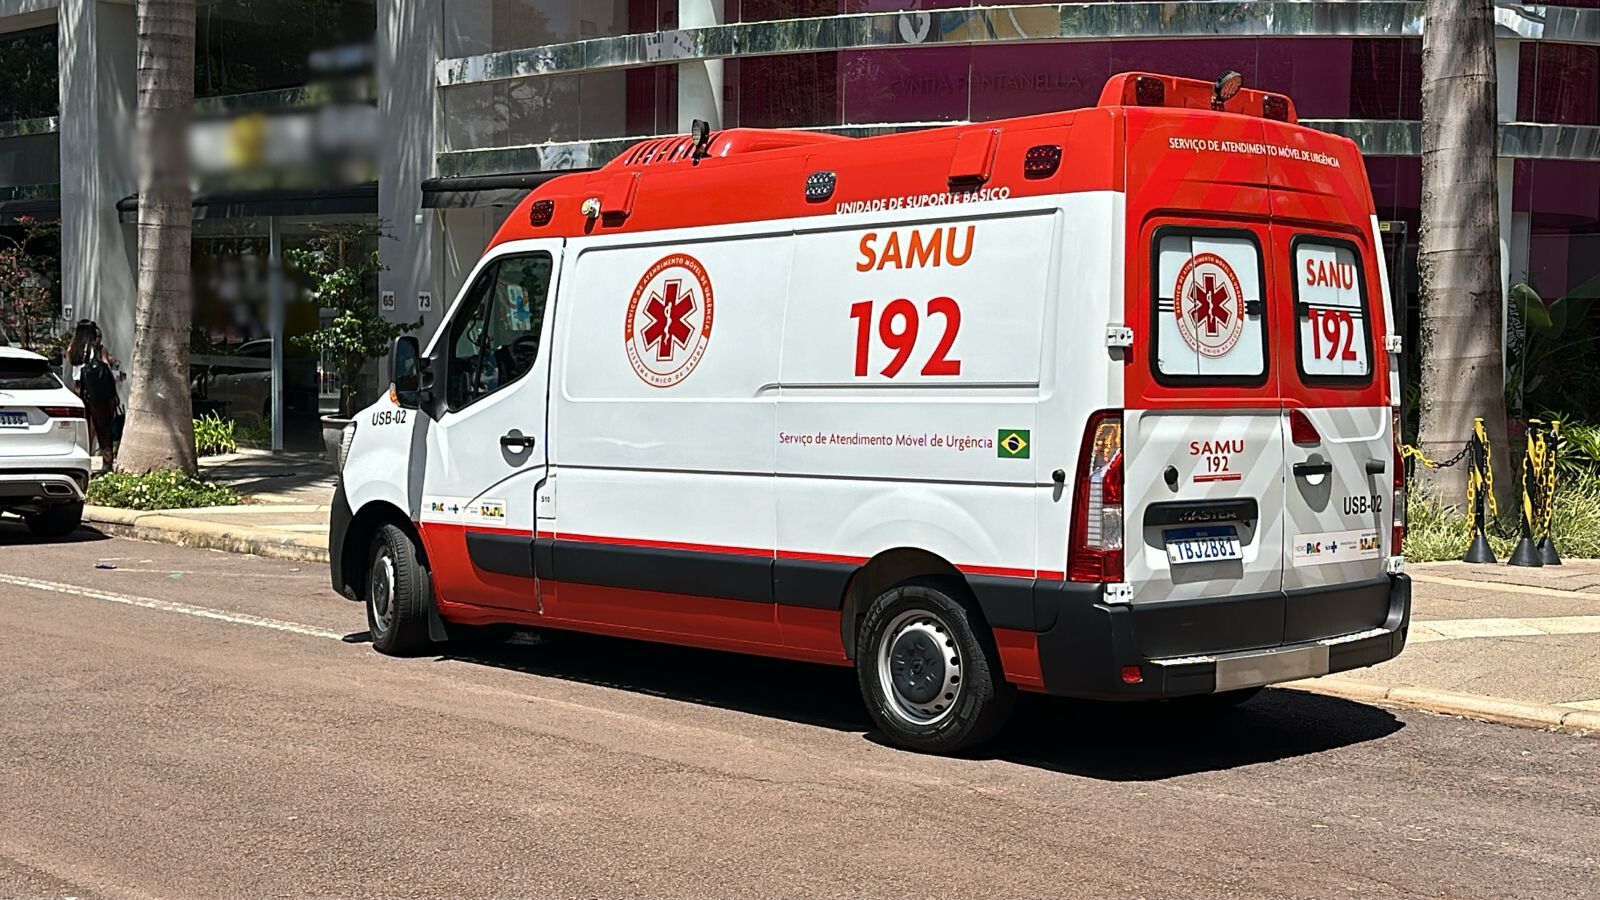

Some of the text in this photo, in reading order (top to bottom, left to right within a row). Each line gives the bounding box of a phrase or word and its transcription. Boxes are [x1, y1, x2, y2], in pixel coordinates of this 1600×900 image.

[1169, 138, 1206, 153] SERVIÇO
[1208, 140, 1219, 151] DE
[1278, 145, 1302, 159] MÓVEL
[1301, 150, 1310, 161] DE
[836, 199, 887, 214] UNIDADE
[889, 197, 904, 210] DE
[906, 192, 960, 209] SUPORTE
[856, 225, 976, 273] SAMU
[383, 295, 394, 307] 65
[418, 295, 430, 308] 73
[850, 296, 961, 379] 192
[1308, 308, 1357, 361] 192
[372, 409, 407, 426] USB-02
[779, 432, 993, 451] Serviço de Atendimento Móvel de Urgência
[1190, 440, 1244, 455] SAMU
[1206, 456, 1229, 472] 192
[432, 502, 444, 512] PAC
[1343, 495, 1382, 515] USB-02
[1179, 511, 1237, 521] MASTER
[1174, 537, 1236, 560] TBJ2B81
[1306, 542, 1321, 554] PAC
